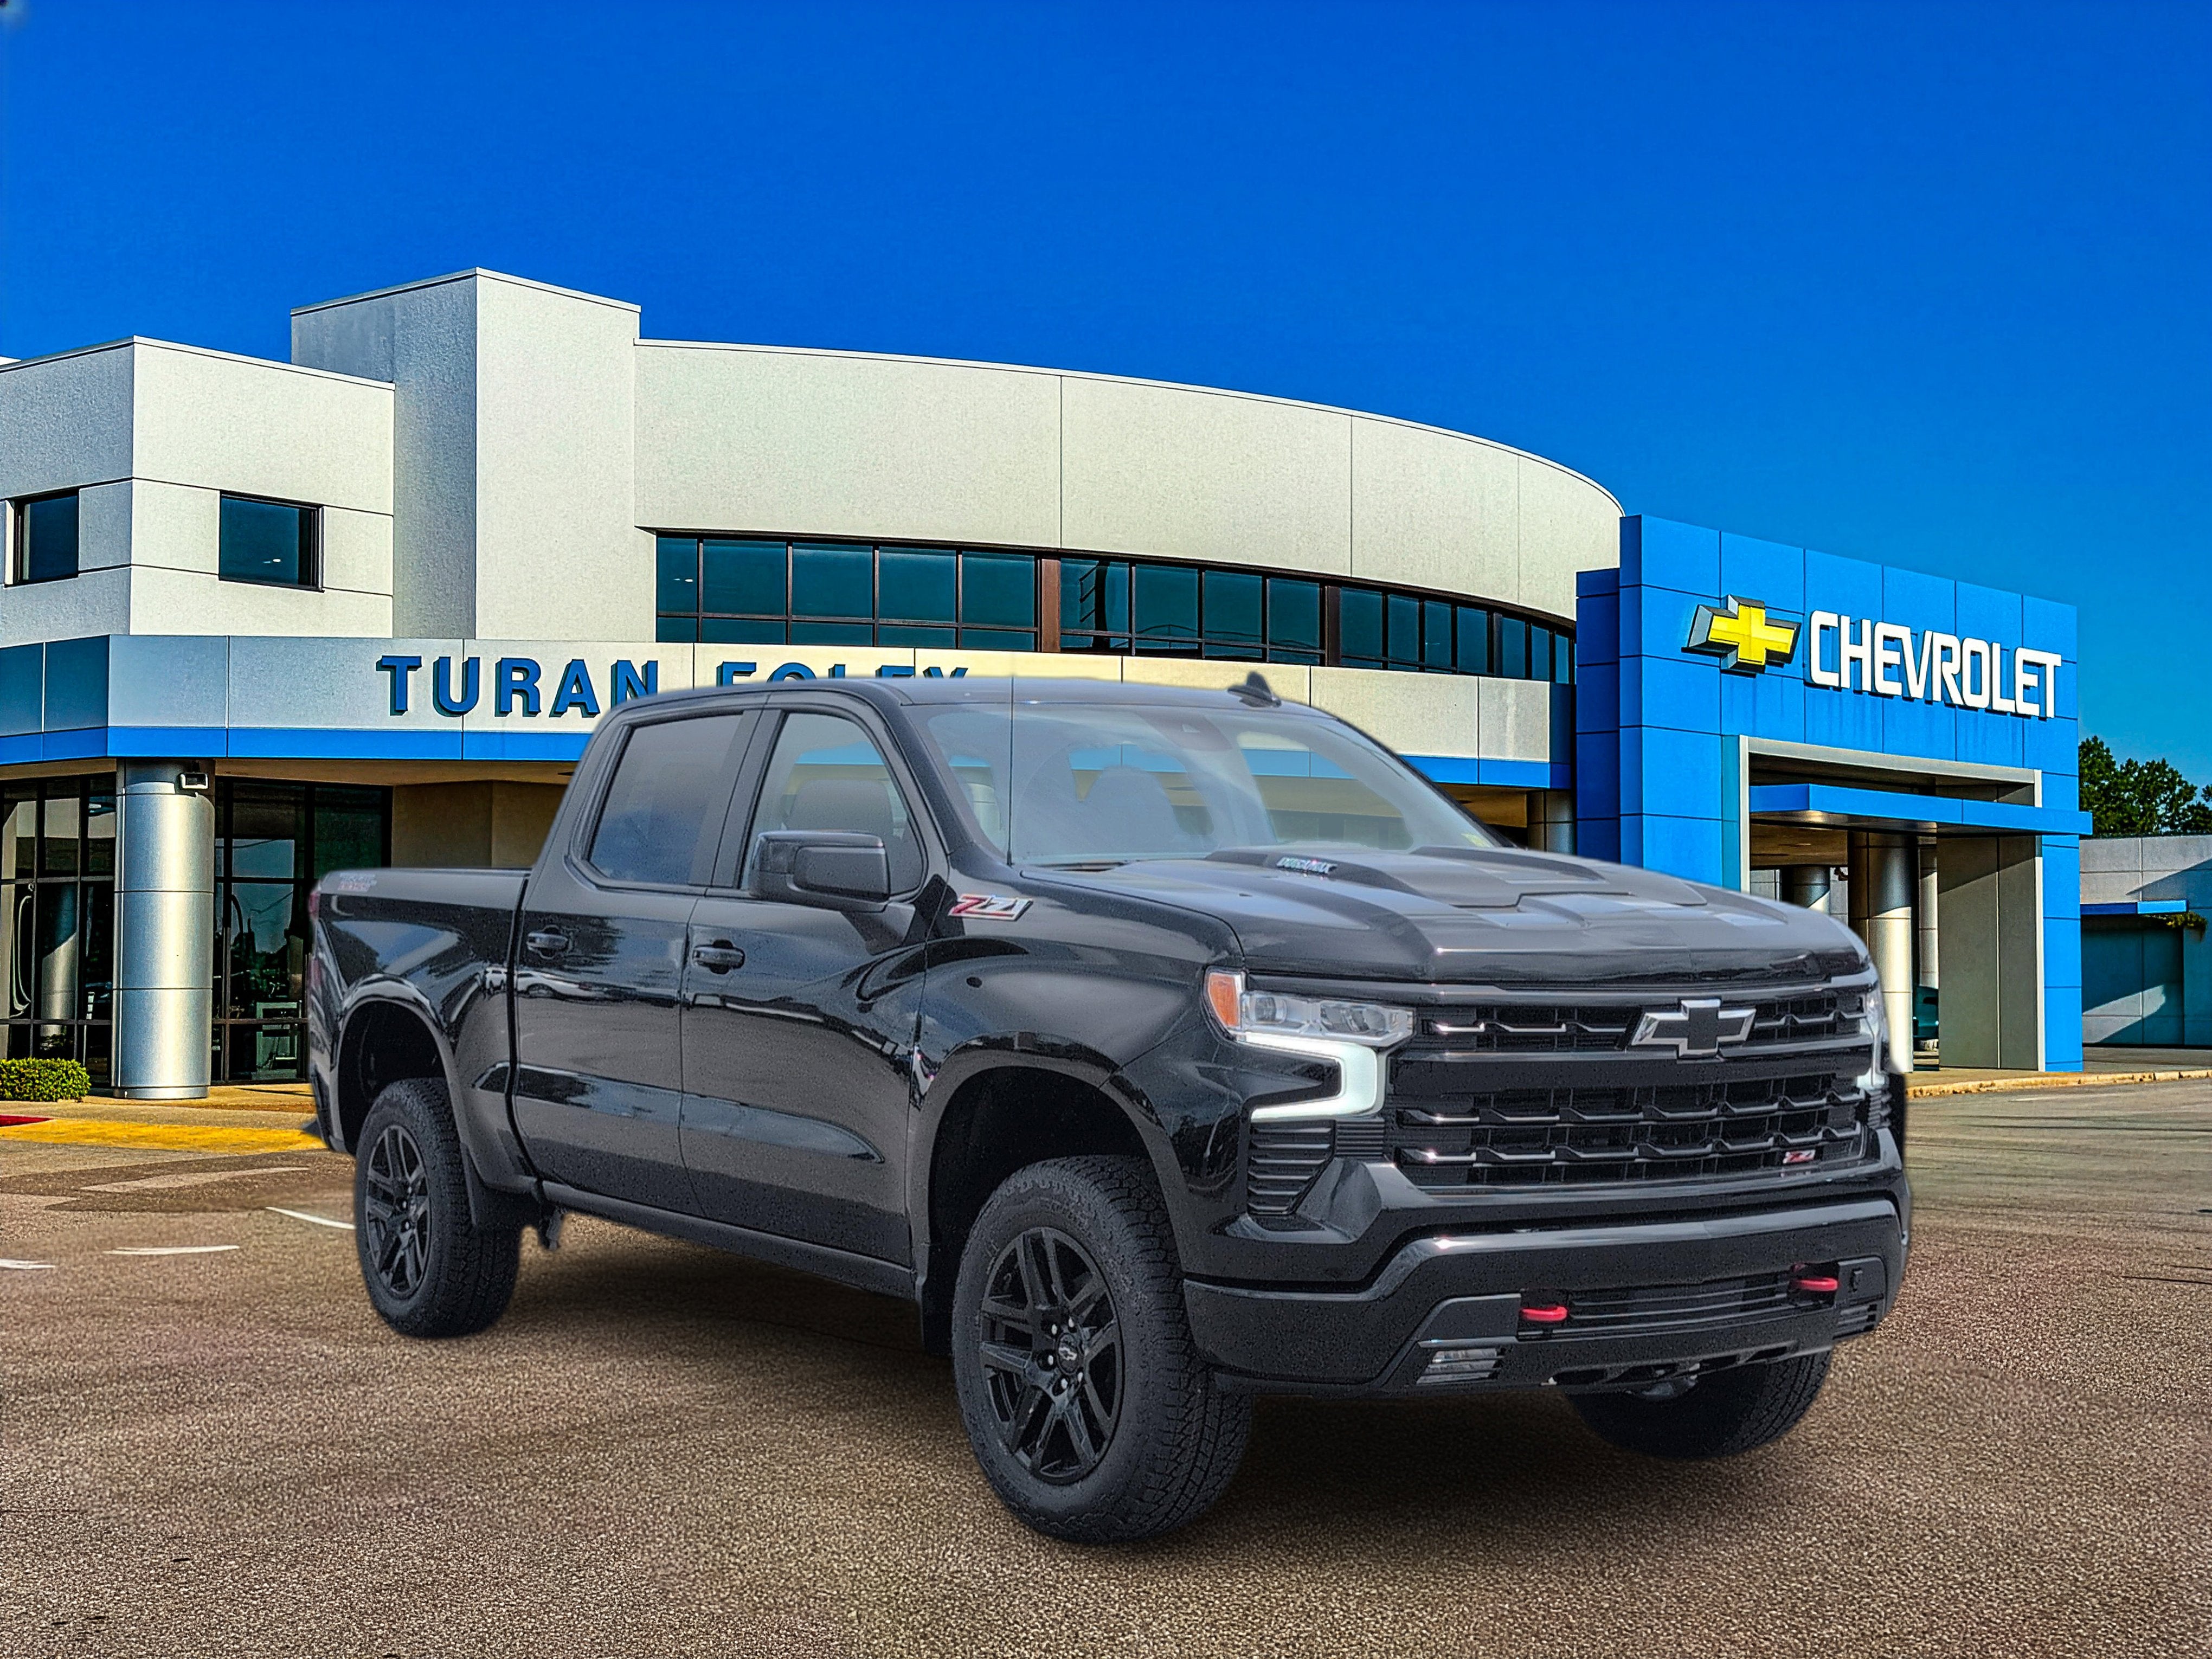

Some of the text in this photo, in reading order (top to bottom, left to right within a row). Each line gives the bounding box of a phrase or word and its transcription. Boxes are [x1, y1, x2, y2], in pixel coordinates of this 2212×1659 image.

[376, 655, 658, 717] TURAN
[1809, 610, 2062, 719] CHEVROLET
[948, 893, 1033, 921] Z71
